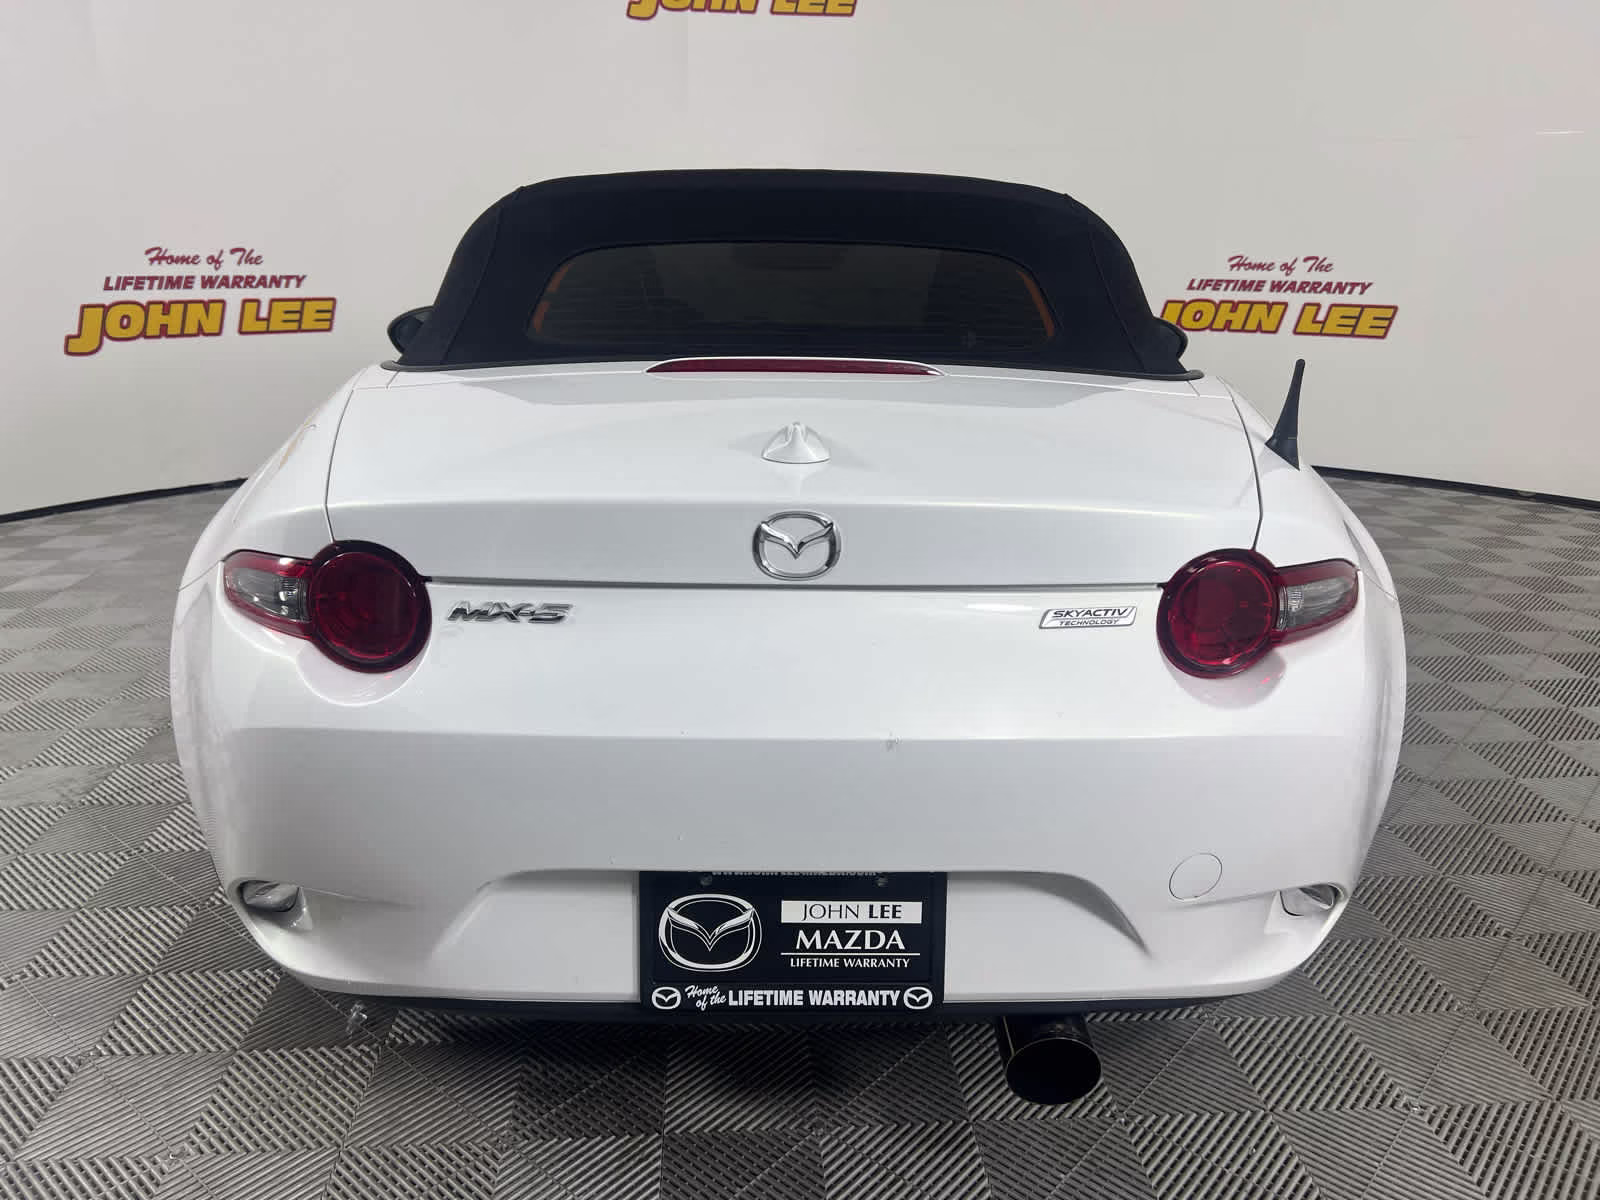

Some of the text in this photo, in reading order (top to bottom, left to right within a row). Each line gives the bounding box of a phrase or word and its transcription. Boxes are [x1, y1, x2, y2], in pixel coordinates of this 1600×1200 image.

[145, 247, 263, 270] Home of The
[1228, 255, 1334, 276] Home of The
[103, 275, 306, 290] LIFETIME WARRANTY
[1186, 279, 1373, 295] LIFETIME WARRANTY
[64, 297, 336, 356] JOHN LEE
[1293, 303, 1398, 339] LEE
[447, 600, 573, 624] MX-5
[1052, 608, 1128, 618] SKYACTIV
[802, 904, 902, 921] JOHN LEE
[796, 929, 906, 950] MAZDA
[790, 957, 910, 968] LIFETIME WARRANTY
[685, 985, 718, 998] Home
[728, 990, 900, 1006] LIFETIME WARRANTY
[696, 991, 727, 1011] of the
